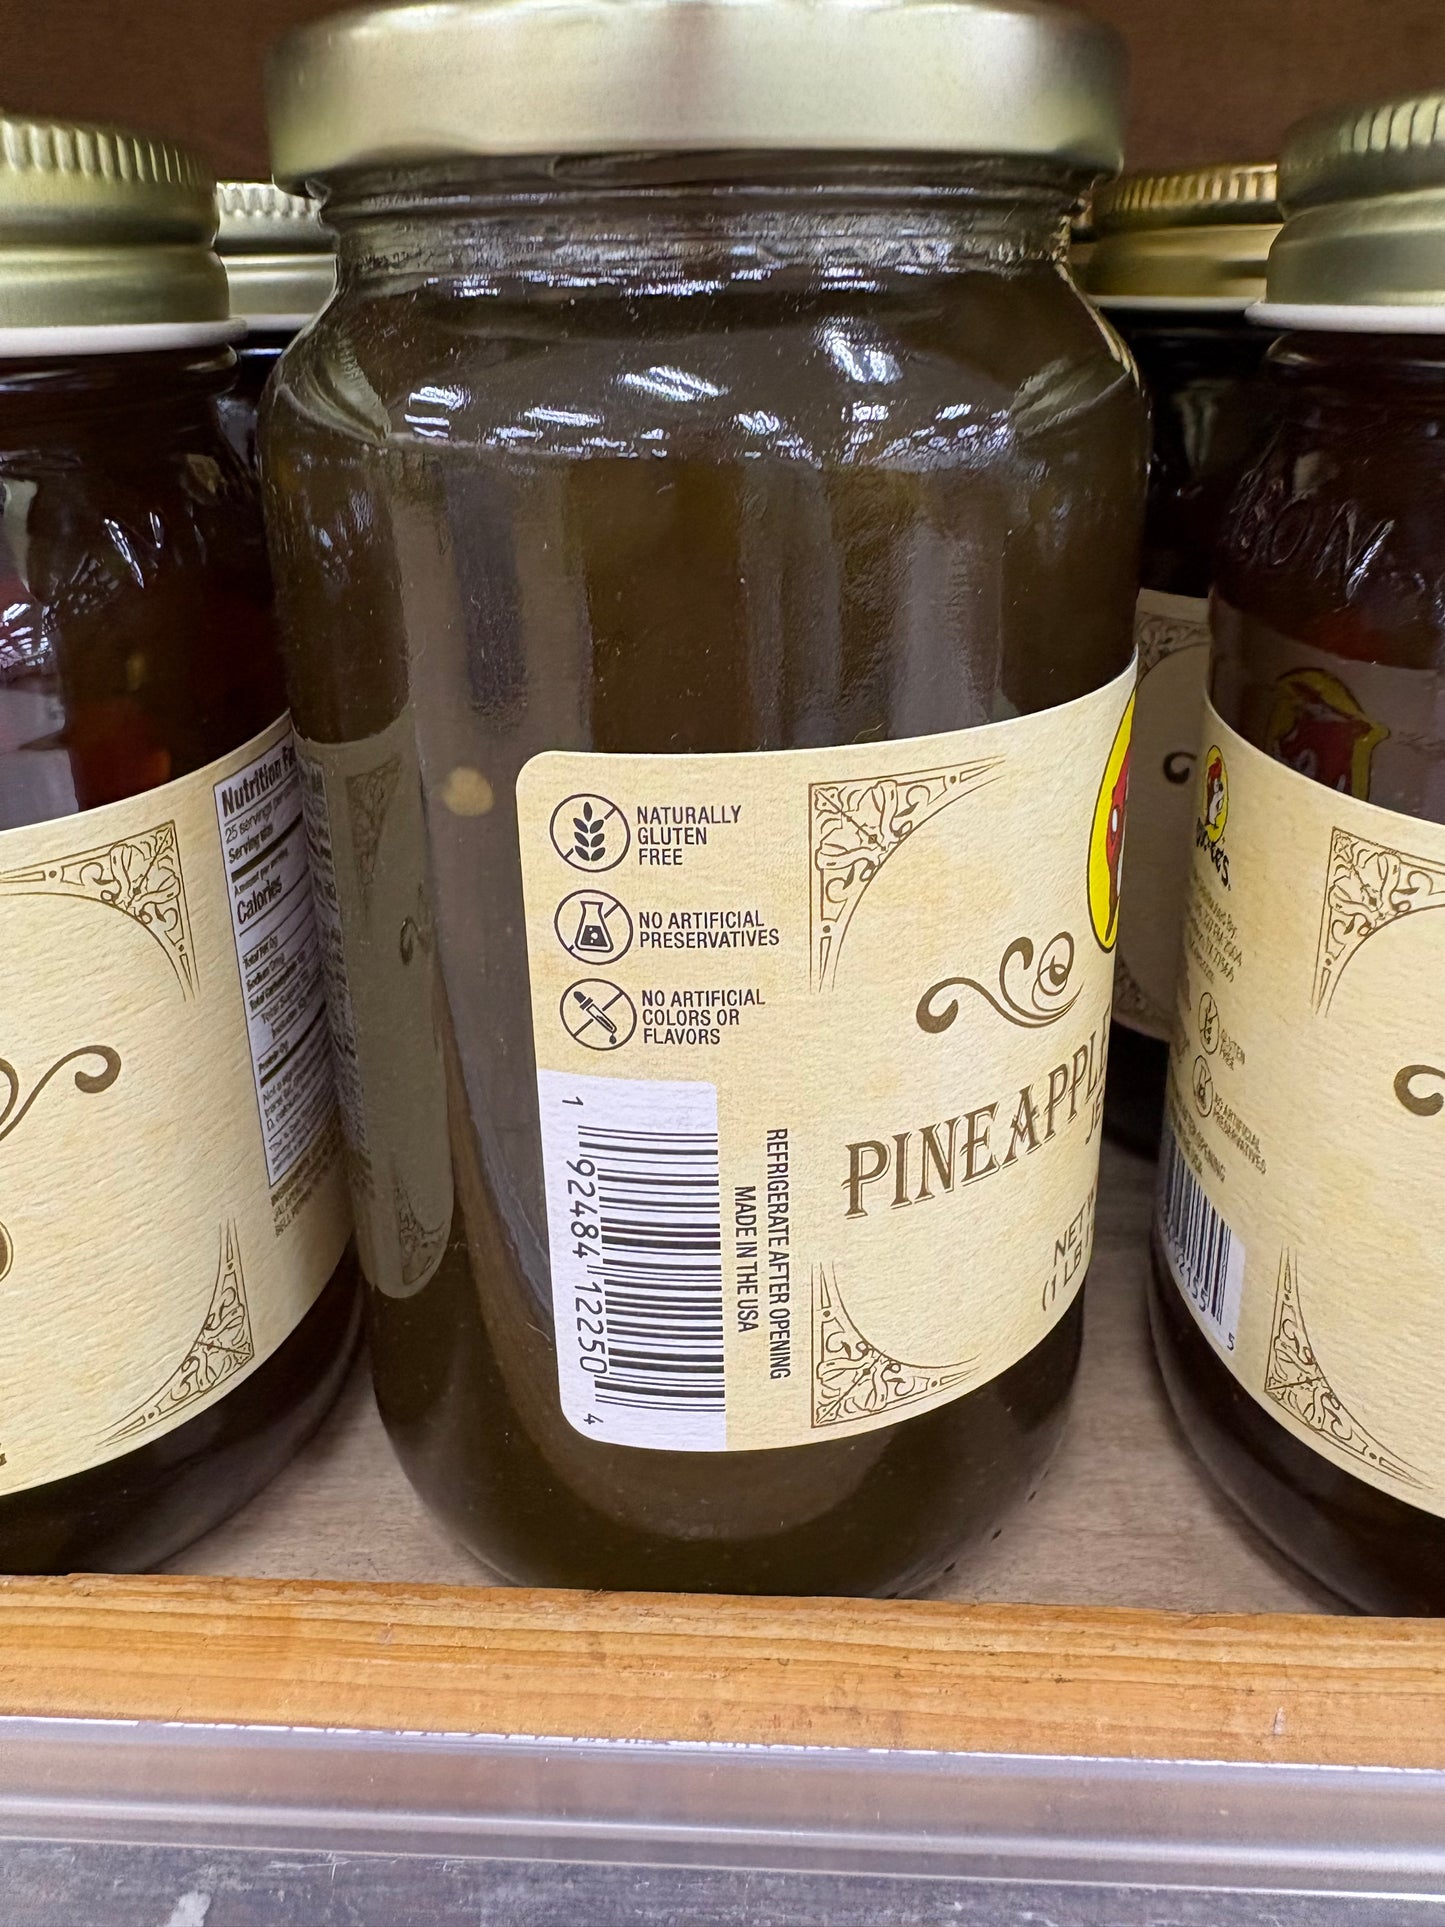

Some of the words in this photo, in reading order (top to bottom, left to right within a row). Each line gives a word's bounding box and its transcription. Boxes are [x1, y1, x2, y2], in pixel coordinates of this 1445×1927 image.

[221, 759, 282, 818] Nutrition
[637, 805, 742, 825] NATURALLY
[638, 827, 708, 846] GLUTEN
[639, 849, 683, 866] FREE
[237, 875, 282, 925] Calories
[639, 912, 663, 929] NO
[668, 910, 765, 929] ARTIFICIAL
[640, 929, 780, 949] PRESERVATIVES
[641, 990, 665, 1007] NO
[671, 989, 766, 1007] ARTIFICIAL
[643, 1009, 711, 1026] COLORS
[716, 1009, 740, 1026] OR
[644, 1029, 720, 1045] FLAVORS
[562, 1096, 584, 1107] 1
[766, 1128, 789, 1248] REFRIGERATE
[566, 1159, 600, 1259] 92484
[735, 1186, 757, 1239] MADE
[736, 1240, 757, 1259] IN
[1053, 1202, 1086, 1268] NET
[736, 1261, 758, 1295] THE
[768, 1251, 790, 1305] AFTER
[1063, 1240, 1082, 1288] LB
[574, 1281, 608, 1375] 12250
[737, 1298, 759, 1333] USA
[769, 1308, 791, 1380] OPENING
[583, 1412, 604, 1425] 4
